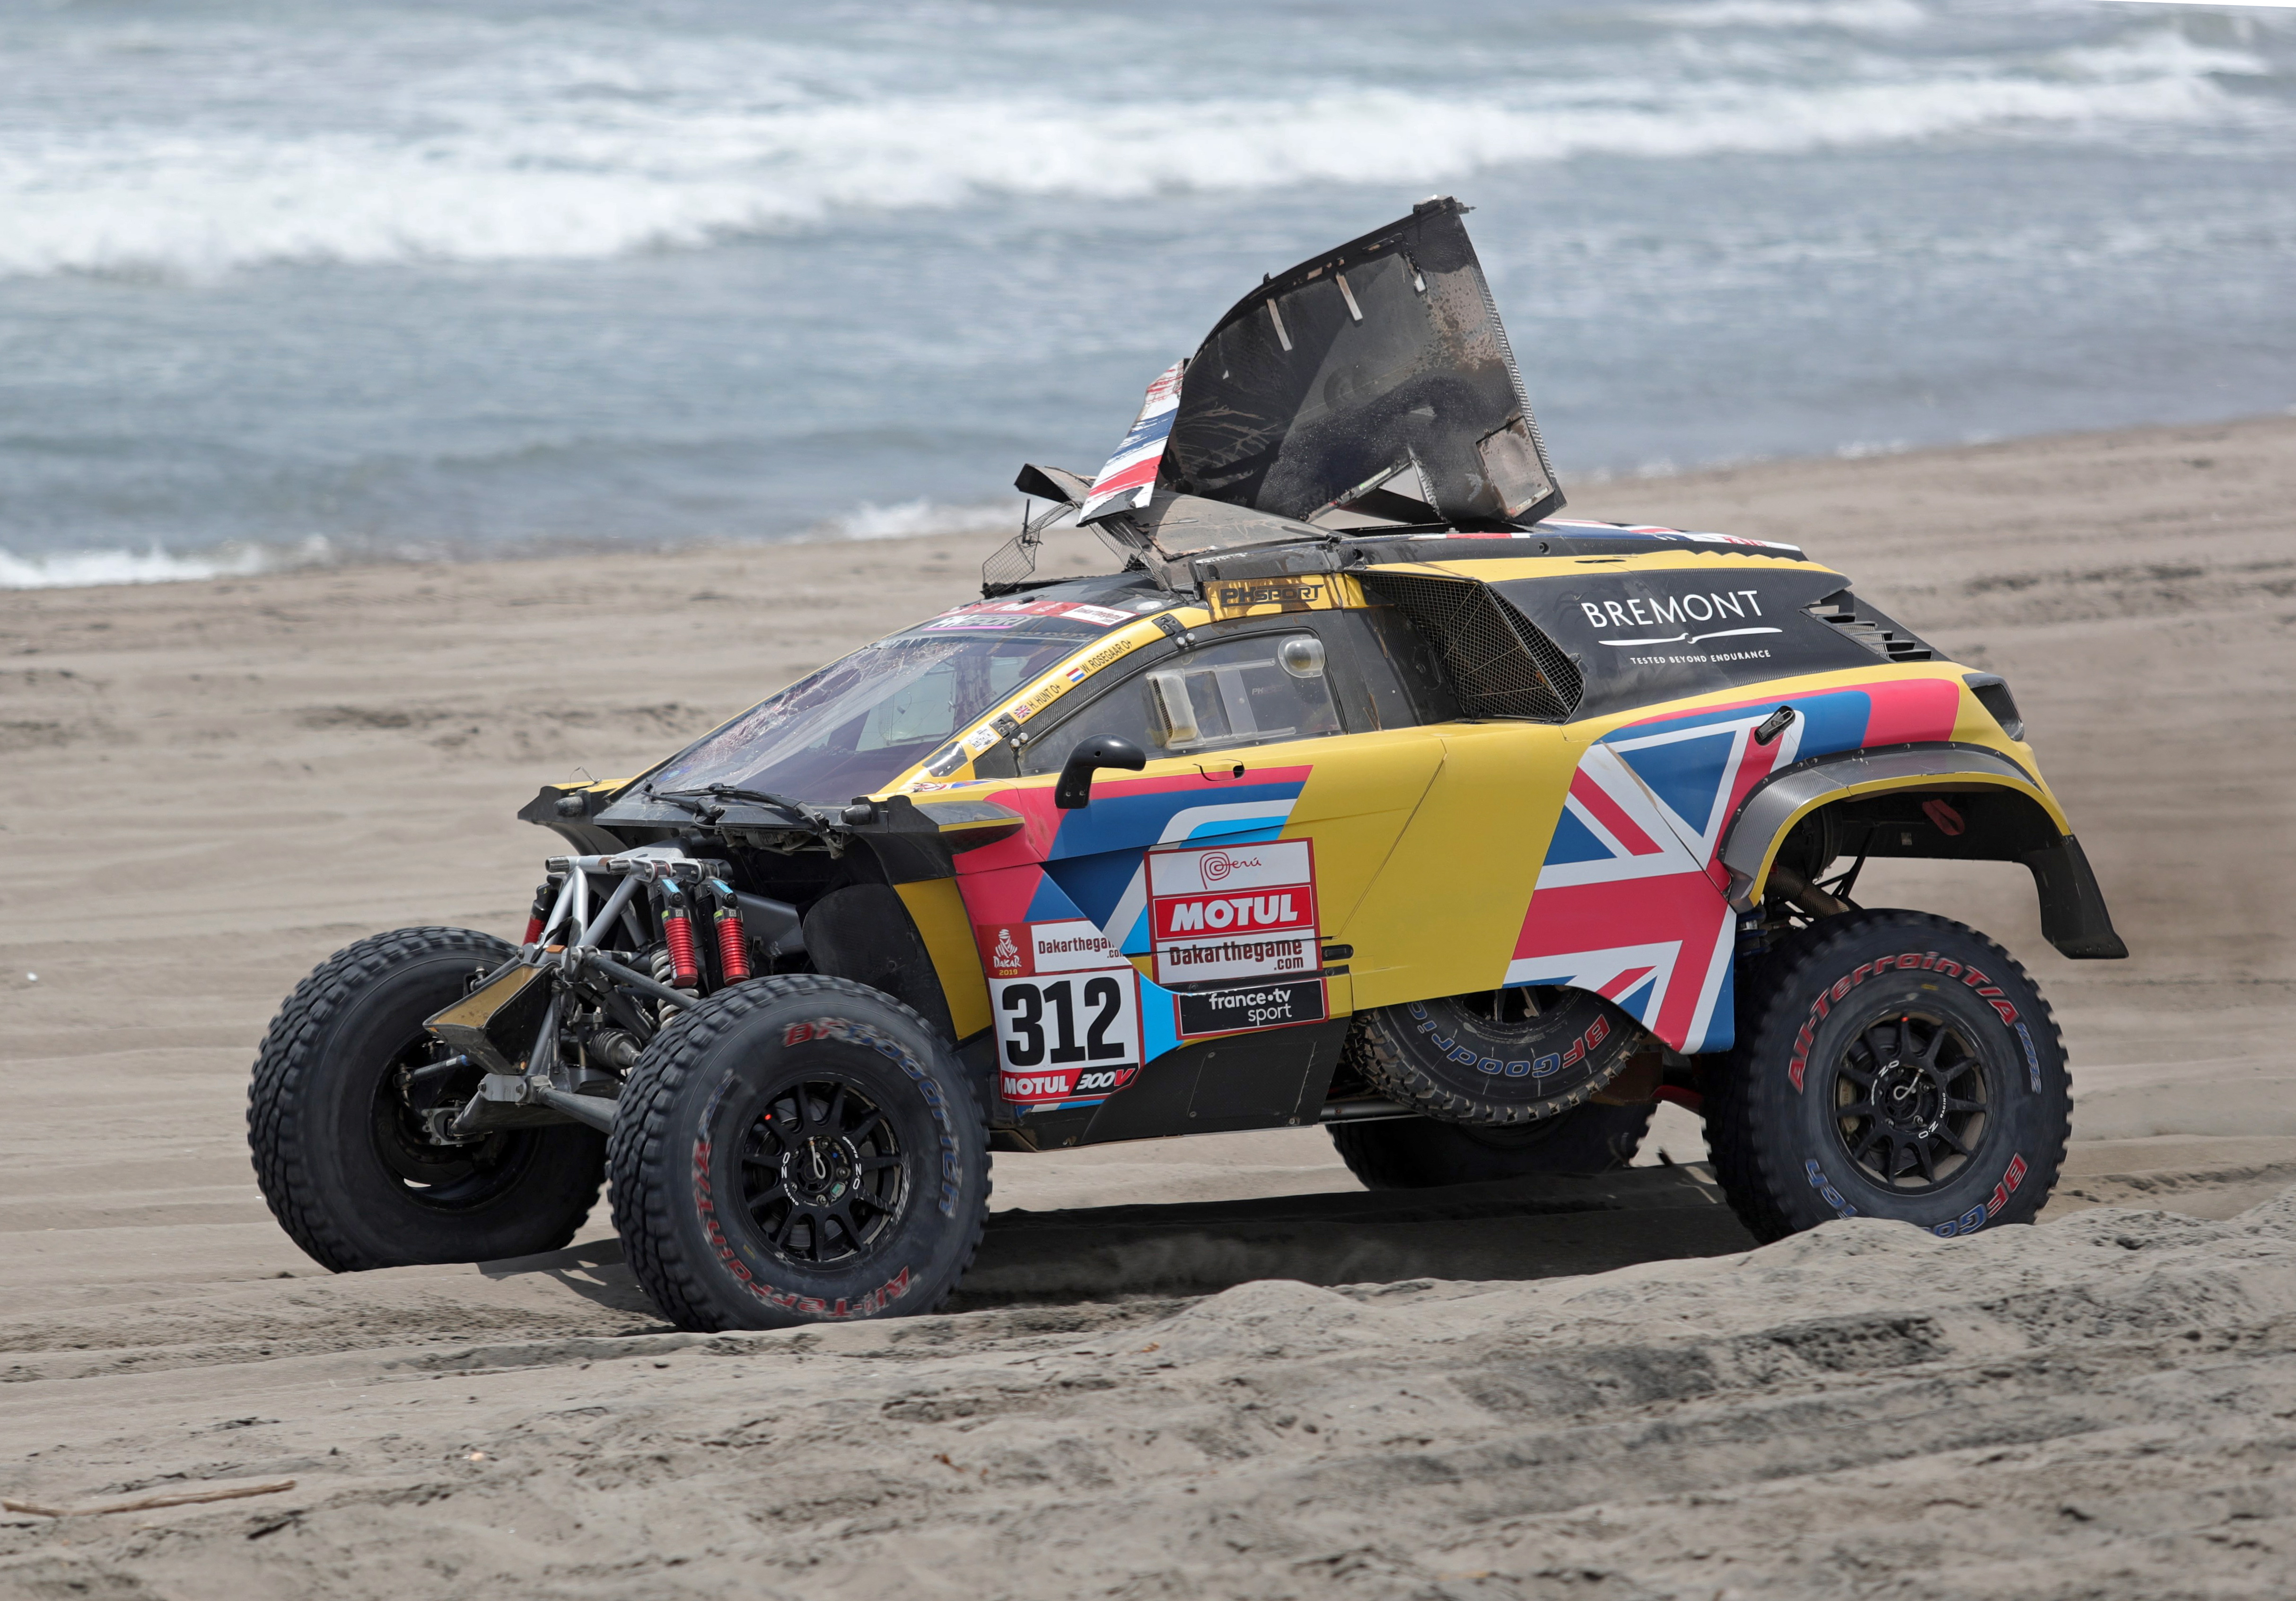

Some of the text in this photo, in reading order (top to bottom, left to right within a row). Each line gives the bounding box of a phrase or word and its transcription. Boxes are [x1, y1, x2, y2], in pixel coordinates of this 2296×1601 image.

[1220, 584, 1324, 607] PHSPORT
[1581, 590, 1763, 628] BREMONT
[1088, 644, 1125, 668] ROSEGAAR
[1630, 649, 1771, 665] TESTED BEYOND ENDURANCE
[1034, 688, 1054, 706] HUNT
[1200, 851, 1262, 890] Perú
[1170, 893, 1298, 932] MOTUL
[1038, 936, 1115, 955] Dakarthega
[1169, 939, 1303, 966] Dakarthegame
[993, 955, 1021, 968] DAKAR
[1273, 956, 1304, 971] .com
[1002, 976, 1125, 1068] 312
[1247, 1003, 1292, 1026] sport
[1003, 1068, 1136, 1095] MOTUL 300V
